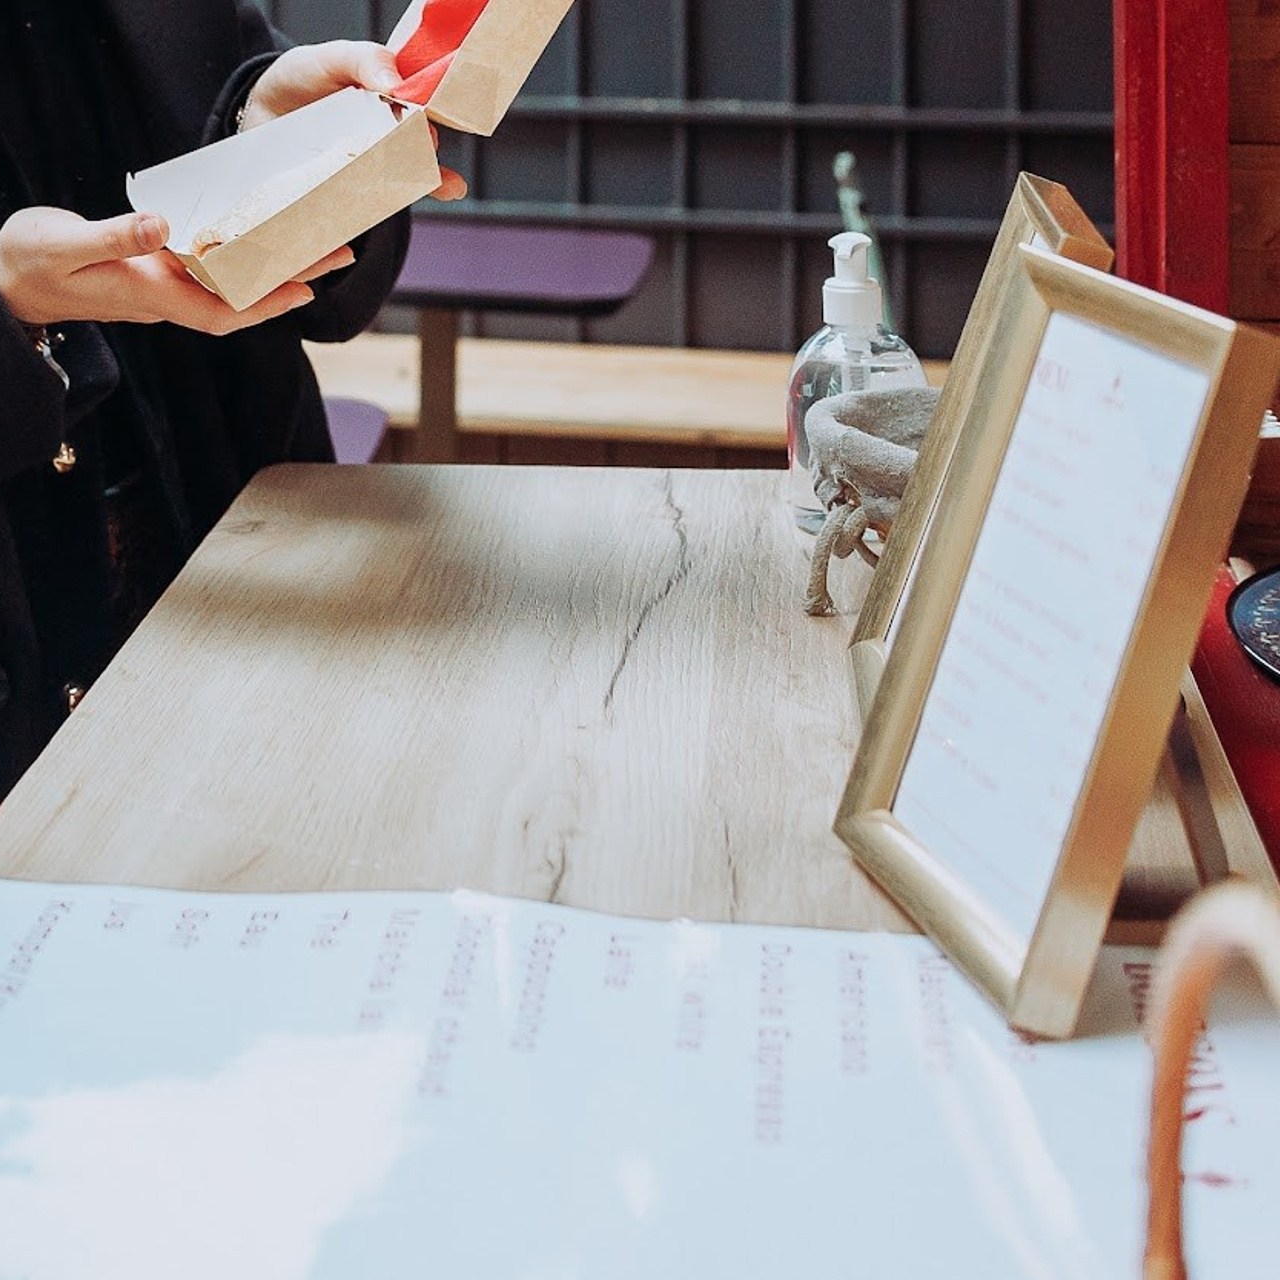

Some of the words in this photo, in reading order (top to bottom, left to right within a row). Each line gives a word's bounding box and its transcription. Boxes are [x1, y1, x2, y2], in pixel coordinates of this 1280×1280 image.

[510, 920, 566, 1052] Cappuccino
[604, 931, 644, 990] Latte
[757, 943, 793, 1017] Double
[839, 948, 870, 1075] Americano
[753, 1026, 790, 1141] Espresso
